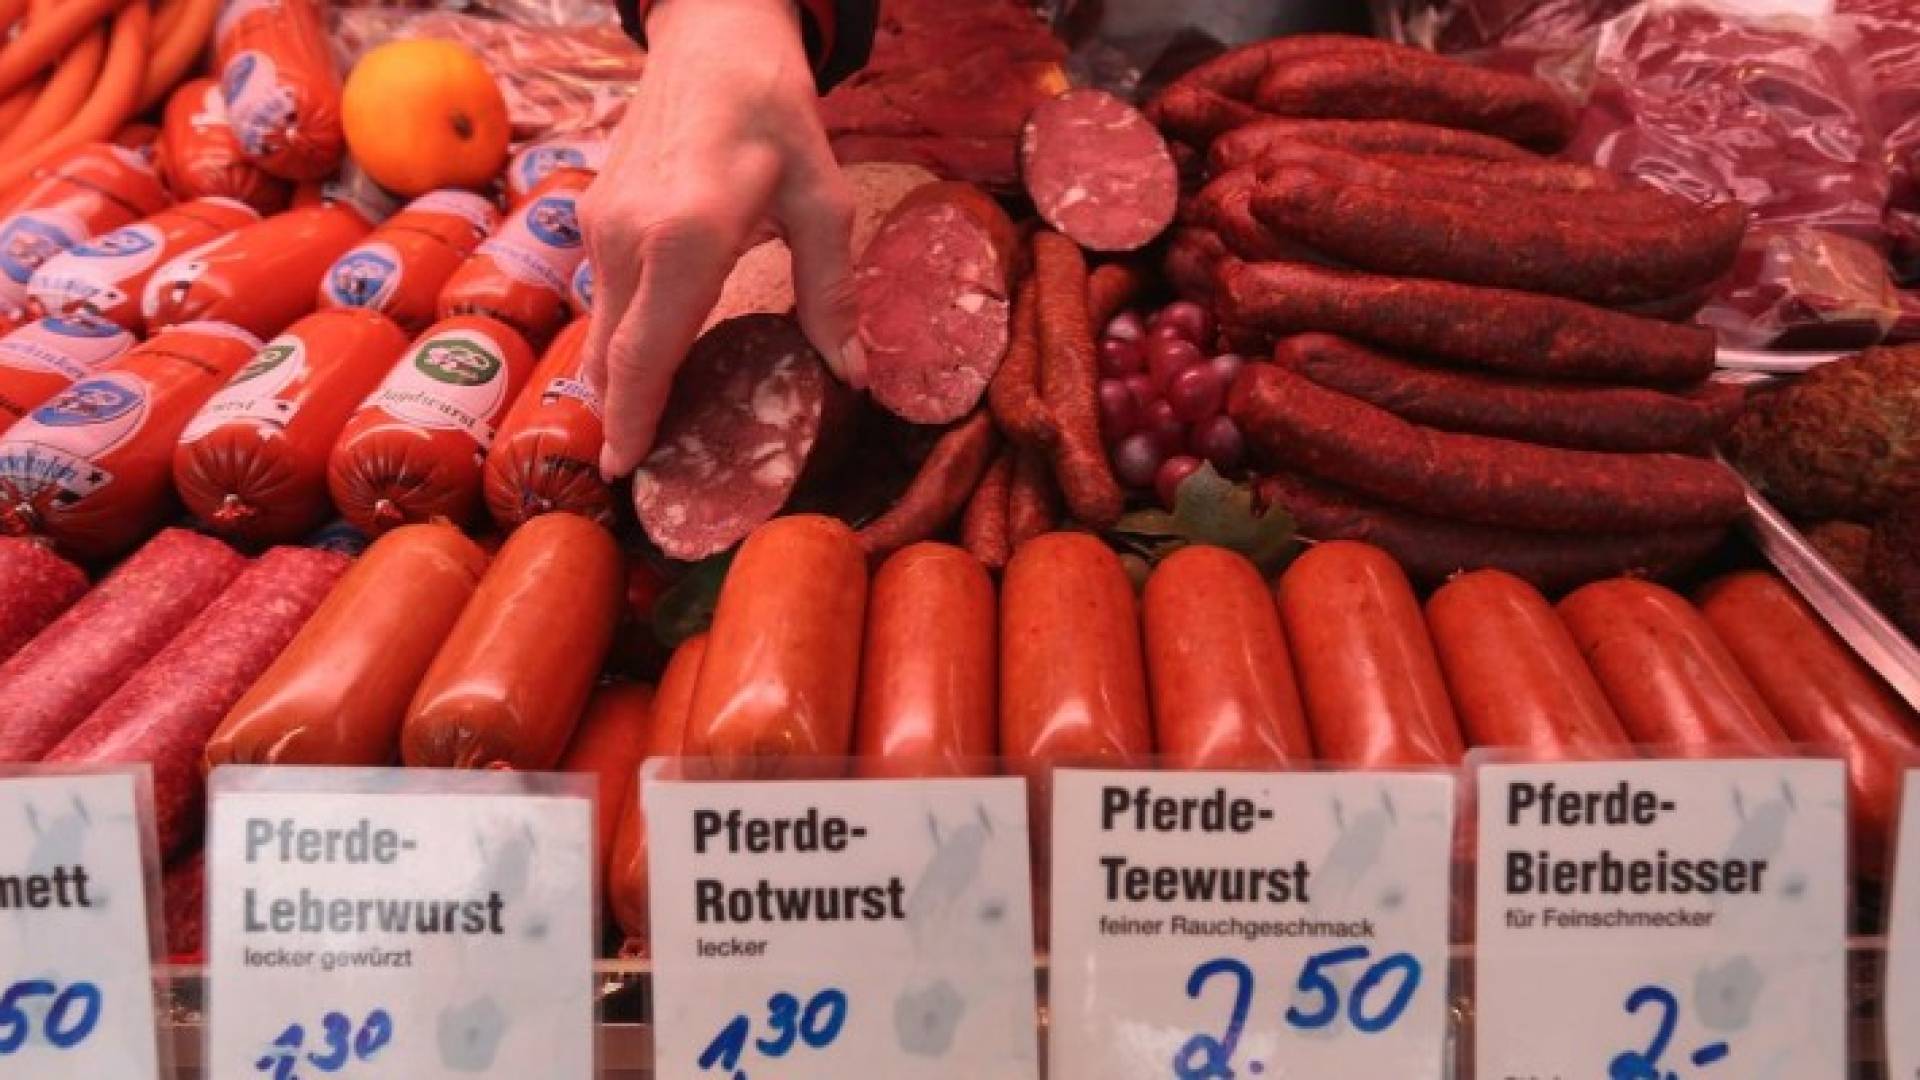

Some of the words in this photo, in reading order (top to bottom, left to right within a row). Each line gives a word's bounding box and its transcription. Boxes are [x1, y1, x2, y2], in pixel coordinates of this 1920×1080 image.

[1101, 785, 1275, 833] Pferde-
[1506, 780, 1676, 826] Pferde-
[244, 817, 417, 865] Pferde-
[693, 807, 868, 854] Pferde-
[1100, 856, 1310, 904] Teewurst
[1505, 849, 1768, 895] Bierbeisser
[243, 888, 505, 936] Leberwurst
[695, 877, 906, 924] Rotwurst
[1504, 908, 1536, 929] für
[1542, 908, 1716, 929] Feinschmecker
[696, 938, 768, 958] lecker
[1099, 916, 1165, 937] feiner
[1170, 915, 1376, 941] Rauchgeschmack
[243, 947, 315, 967] lecker
[321, 945, 413, 971] gewürzt
